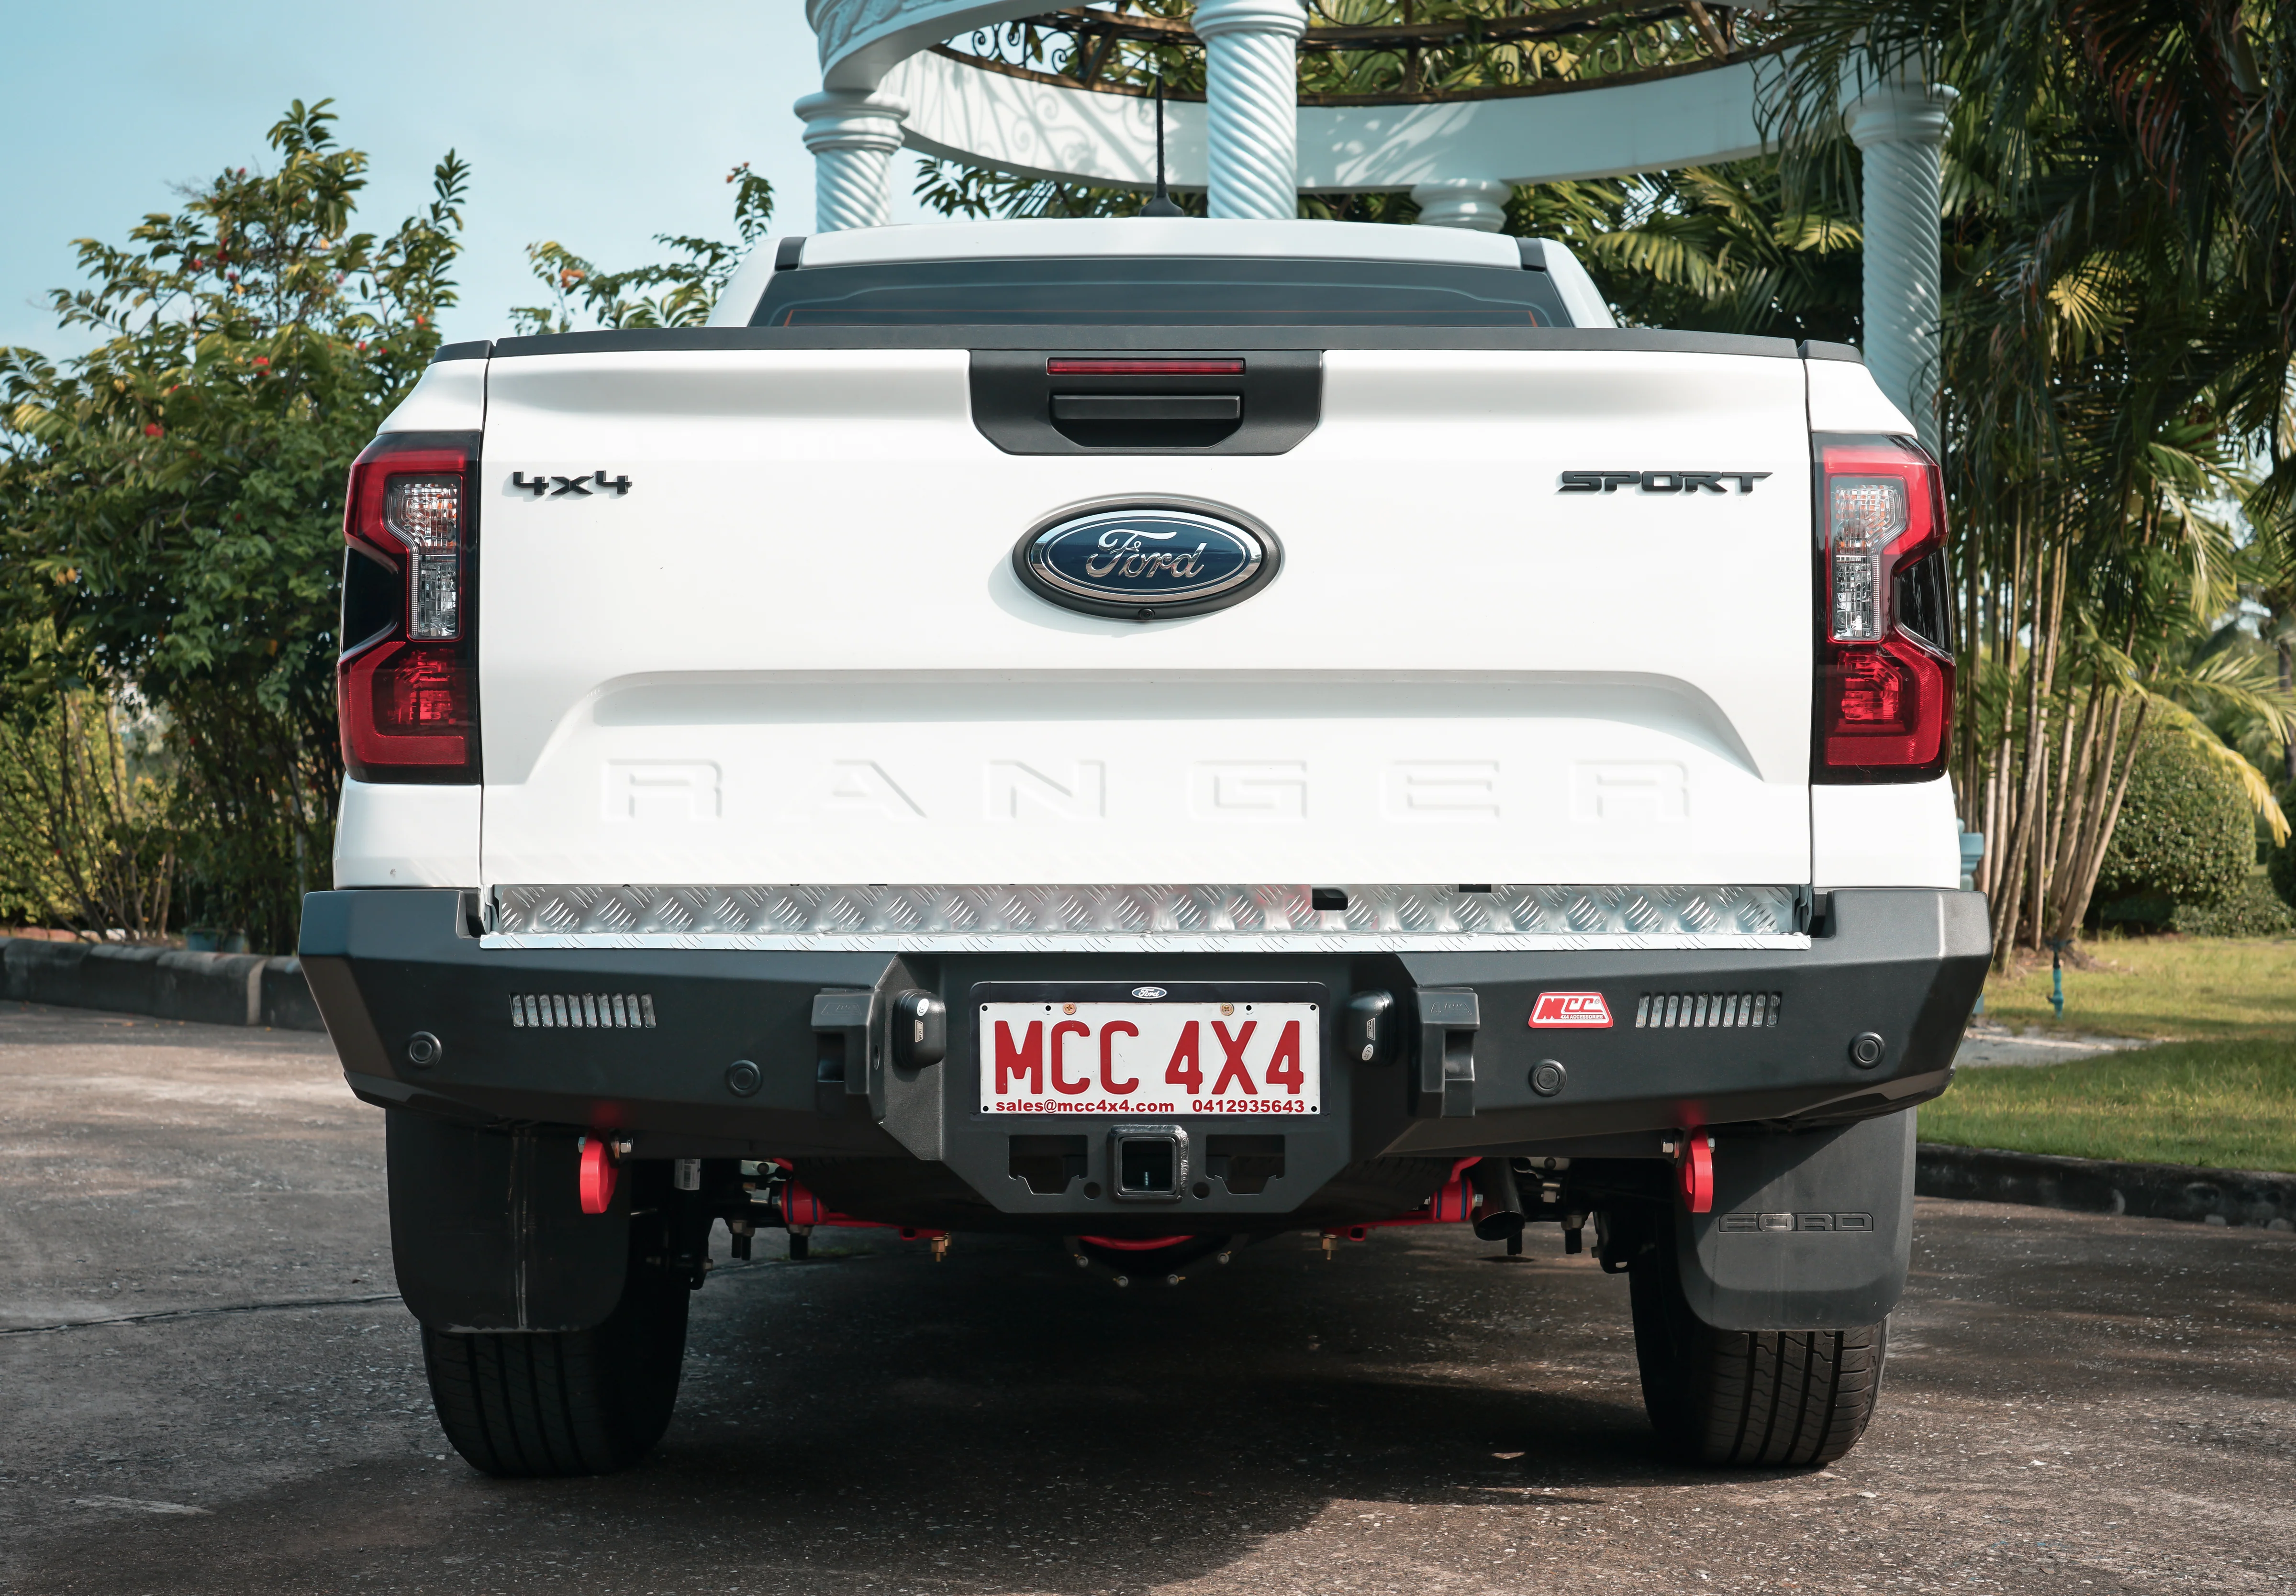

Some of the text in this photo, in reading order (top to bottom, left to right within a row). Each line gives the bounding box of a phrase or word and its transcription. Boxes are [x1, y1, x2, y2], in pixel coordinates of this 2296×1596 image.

[1559, 471, 1773, 492] SPORT
[1085, 529, 1205, 578] Ford
[598, 758, 1691, 823] RANGER
[1138, 988, 1160, 997] Ford
[995, 1020, 1304, 1095] MCC 4X4
[996, 1099, 1304, 1112] sales@mcc4x4.com 0412935643
[1719, 1213, 1873, 1232] FORD
